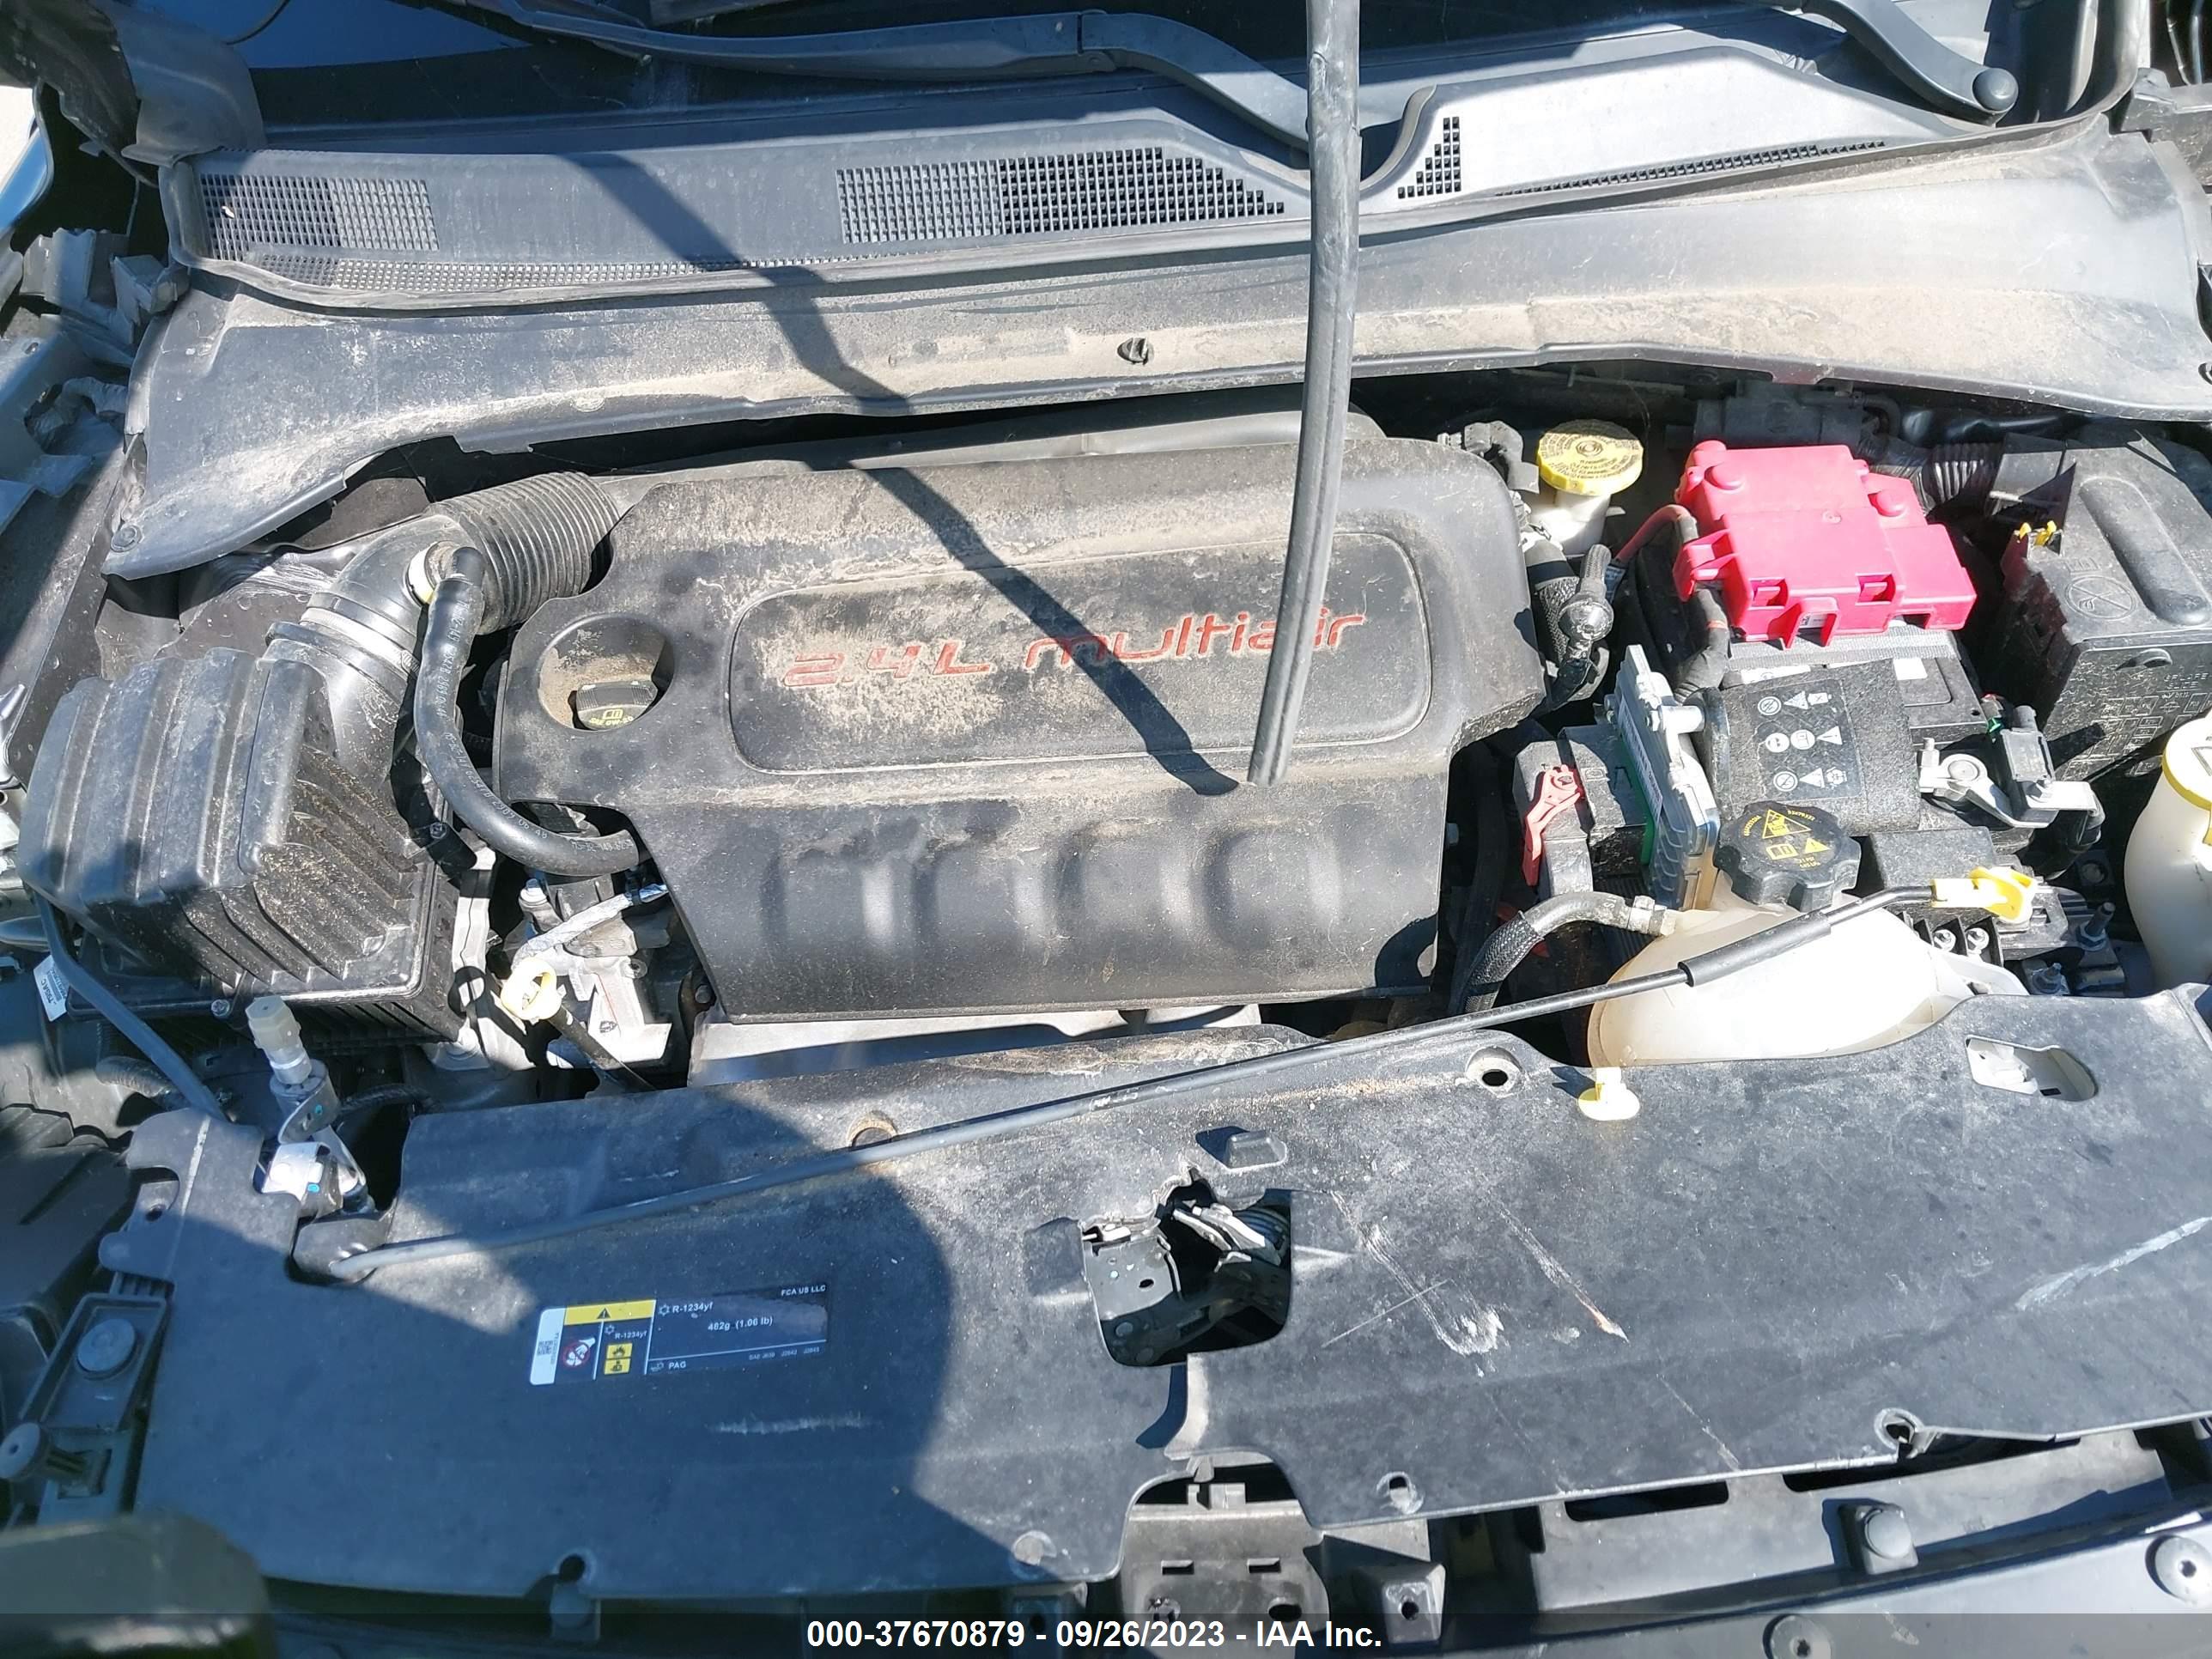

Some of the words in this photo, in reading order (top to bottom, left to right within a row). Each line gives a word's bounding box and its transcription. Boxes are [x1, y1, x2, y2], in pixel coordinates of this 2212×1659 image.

[1024, 605, 1365, 669] multiair
[605, 716, 635, 726] 0W-20
[781, 1288, 797, 1297] FCA
[799, 1286, 809, 1295] US
[811, 1285, 826, 1293] LLC
[672, 1301, 714, 1314] R-1234yf
[761, 1315, 773, 1327] lb)
[614, 1330, 647, 1340] R-1234yf
[668, 1361, 687, 1370] PAG
